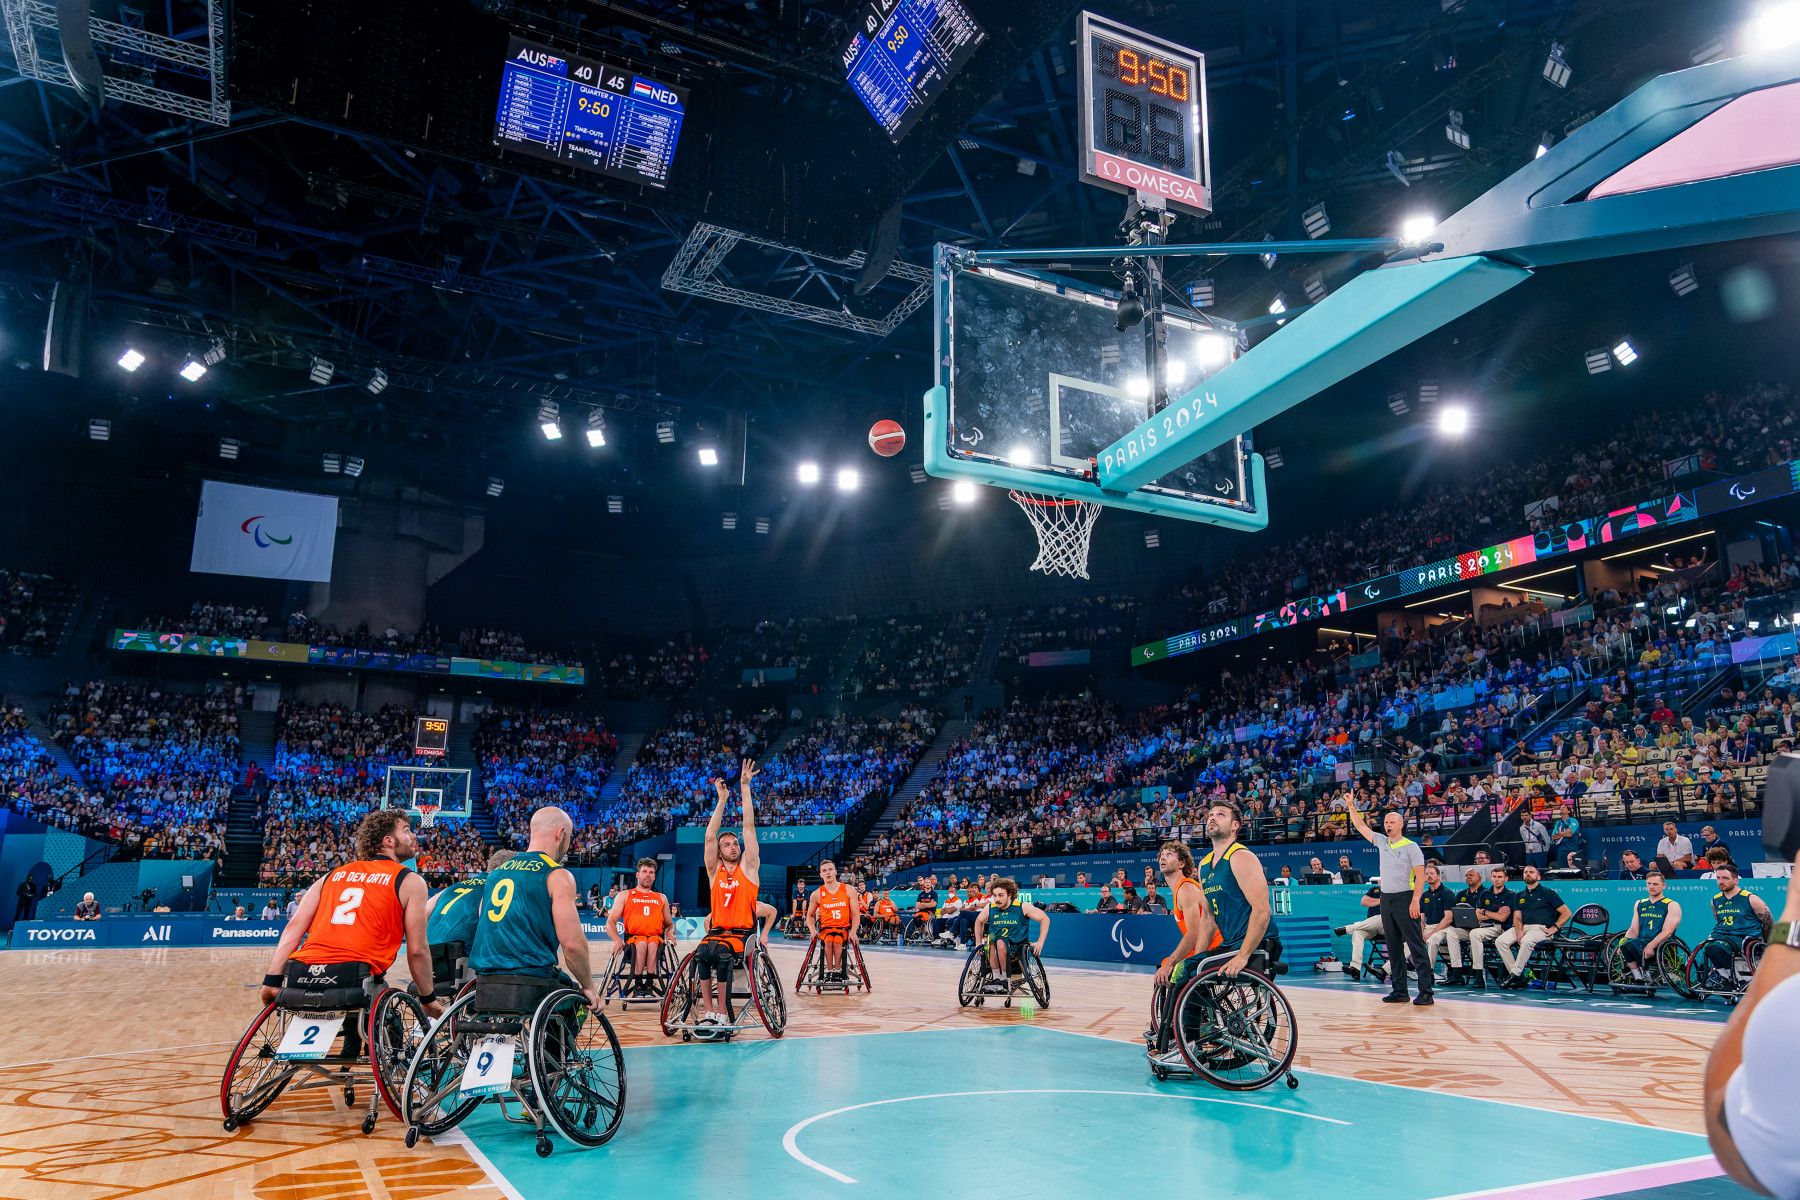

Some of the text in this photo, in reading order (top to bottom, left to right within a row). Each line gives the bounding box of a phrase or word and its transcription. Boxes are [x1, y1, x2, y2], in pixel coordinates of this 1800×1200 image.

[866, 15, 878, 33] 40
[888, 26, 908, 54] 9:50
[517, 48, 547, 67] AUS
[842, 44, 859, 68] AUS
[574, 66, 592, 80] 40
[1118, 49, 1188, 102] 9:50
[606, 76, 624, 90] 45
[580, 86, 609, 99] QUARTER
[650, 88, 678, 105] NED
[578, 98, 610, 118] 9:50
[574, 124, 604, 138] TIME-OUTS
[568, 144, 602, 158] TEAM FOULS
[1126, 167, 1198, 202] OMEGA
[1104, 392, 1218, 474] PARIS 2024
[1418, 550, 1513, 584] PARIS 2024
[1179, 626, 1237, 649] PARIS 2024
[426, 721, 446, 732] 9:50
[762, 831, 795, 840] 2024
[332, 872, 346, 882] OP
[346, 872, 366, 883] DEN
[331, 887, 364, 926] 2
[440, 888, 473, 914] 7
[488, 878, 514, 922] 9
[632, 898, 660, 906] TeamNL
[724, 893, 732, 907] 7
[823, 901, 847, 909] TeamNL
[643, 905, 650, 916] 0
[832, 909, 841, 919] 15
[580, 923, 606, 932] llian
[1648, 920, 1653, 930] 1
[27, 928, 97, 940] TOYOTA
[212, 927, 280, 939] Panasonic
[1001, 928, 1008, 937] 2
[299, 1025, 320, 1045] 2
[477, 1052, 494, 1076] 9
